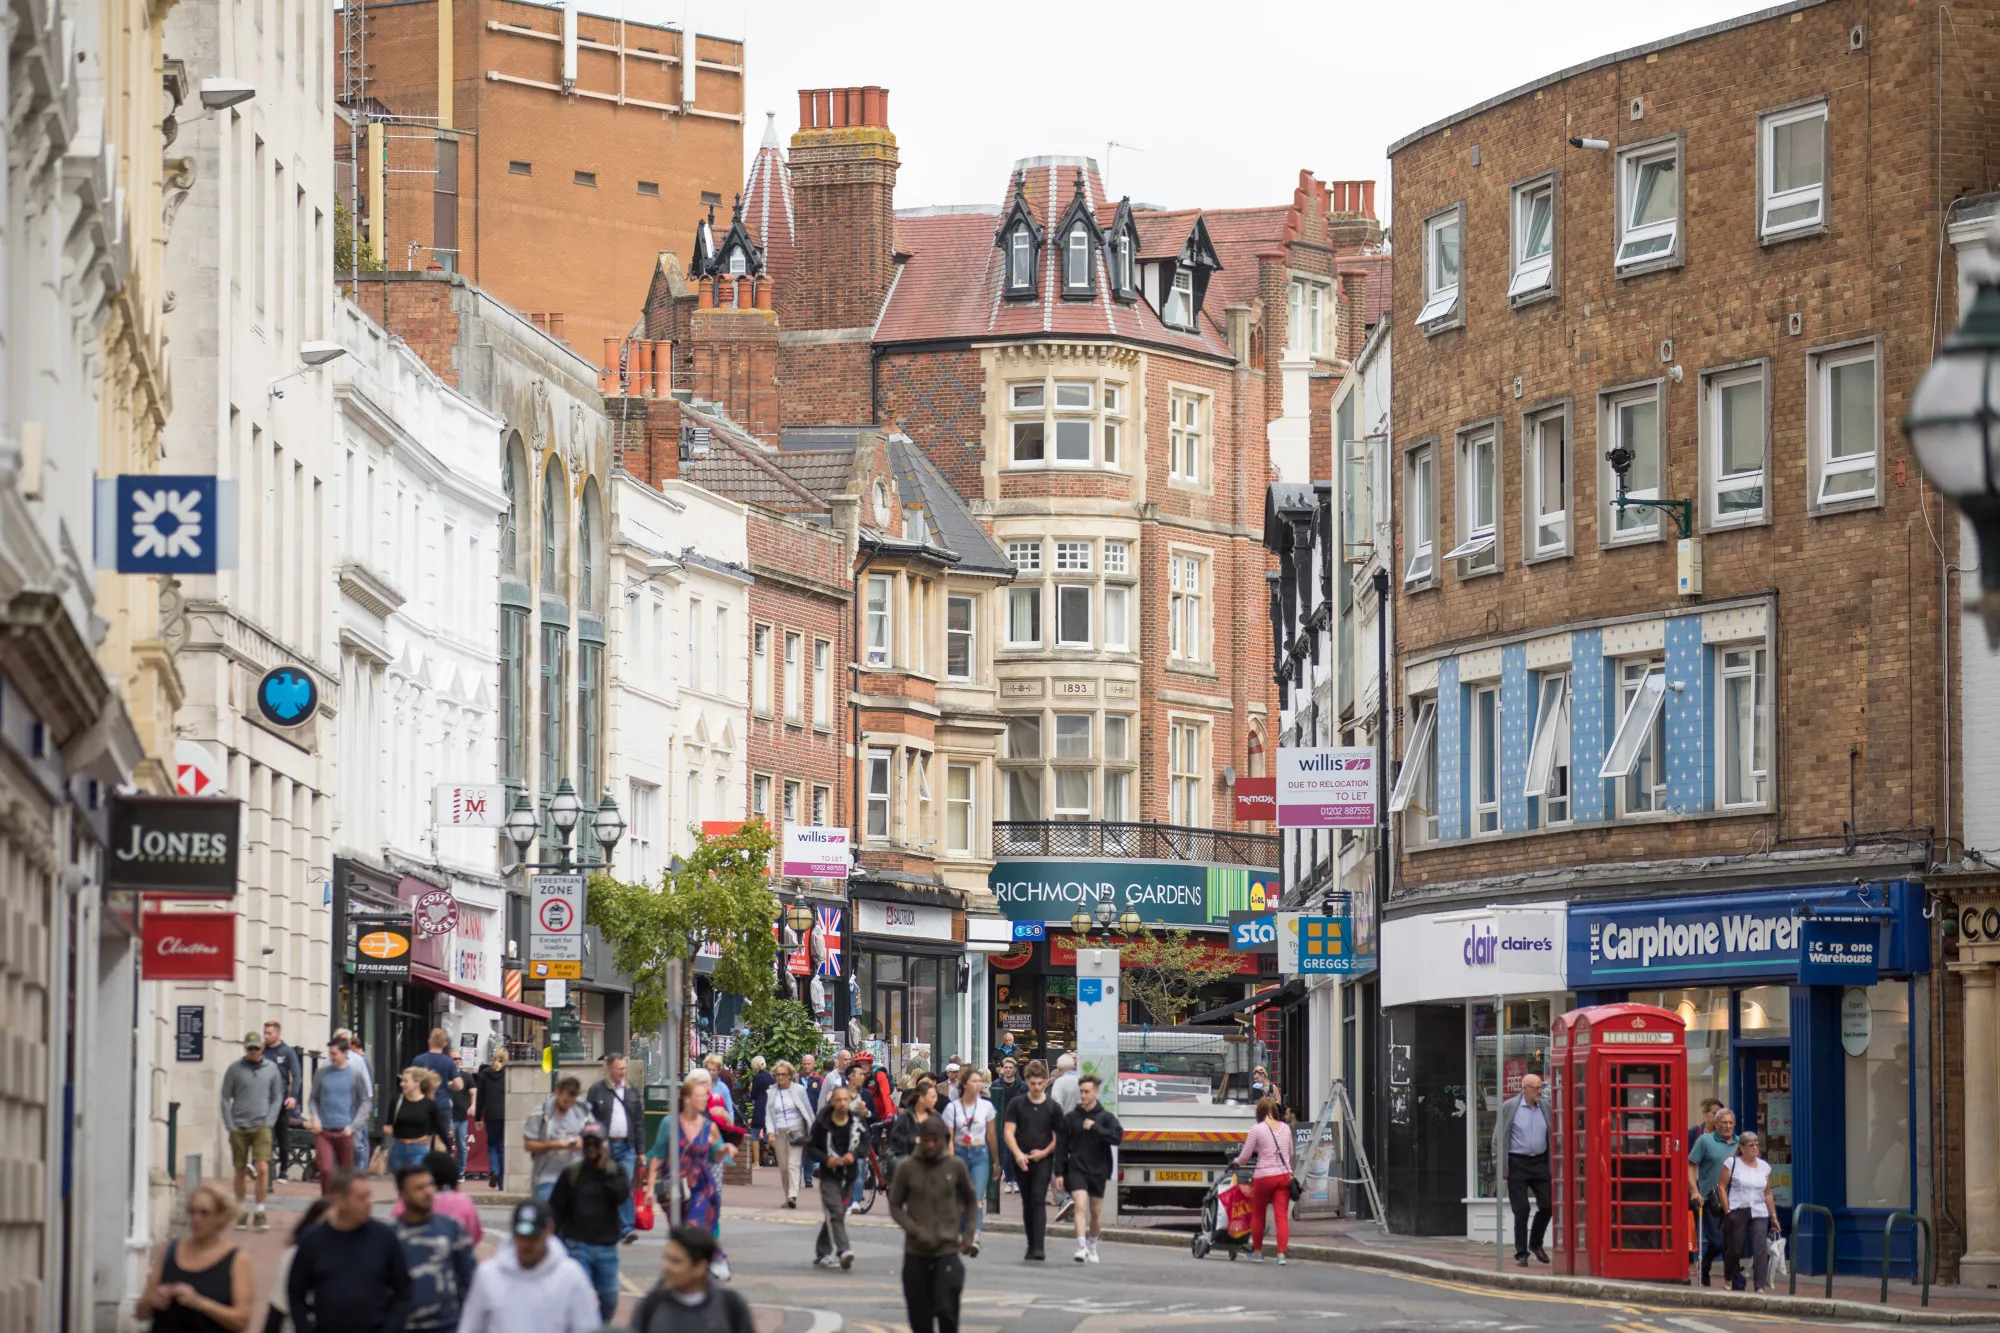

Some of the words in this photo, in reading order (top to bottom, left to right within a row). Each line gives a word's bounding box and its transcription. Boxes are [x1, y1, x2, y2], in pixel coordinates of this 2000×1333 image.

[1063, 684, 1087, 693] 1893
[1329, 750, 1372, 759] commercial
[1298, 753, 1343, 771] willis
[1288, 781, 1305, 789] DUE
[1319, 780, 1369, 788] RELOCATION
[1335, 792, 1349, 801] TO
[1351, 792, 1368, 801] LET
[1320, 807, 1343, 816] 01202
[1344, 806, 1371, 816] 887555
[797, 830, 827, 843] willis
[540, 885, 573, 895] ZONE
[995, 881, 1116, 902] RICHMOND
[1124, 883, 1202, 906] GARDENS
[421, 893, 452, 906] COSTA
[420, 916, 456, 932] COFFEE
[1237, 920, 1275, 944] sta
[1500, 936, 1553, 952] claire's
[1590, 923, 1600, 964] THE
[1602, 917, 1720, 967] Carphone
[1303, 958, 1349, 970] GREGGS
[1809, 952, 1873, 964] Warehouse
[357, 963, 409, 972] TRAILFINDERS
[1607, 1032, 1663, 1043] TELEPHON
[1180, 1171, 1198, 1181] EYZ
